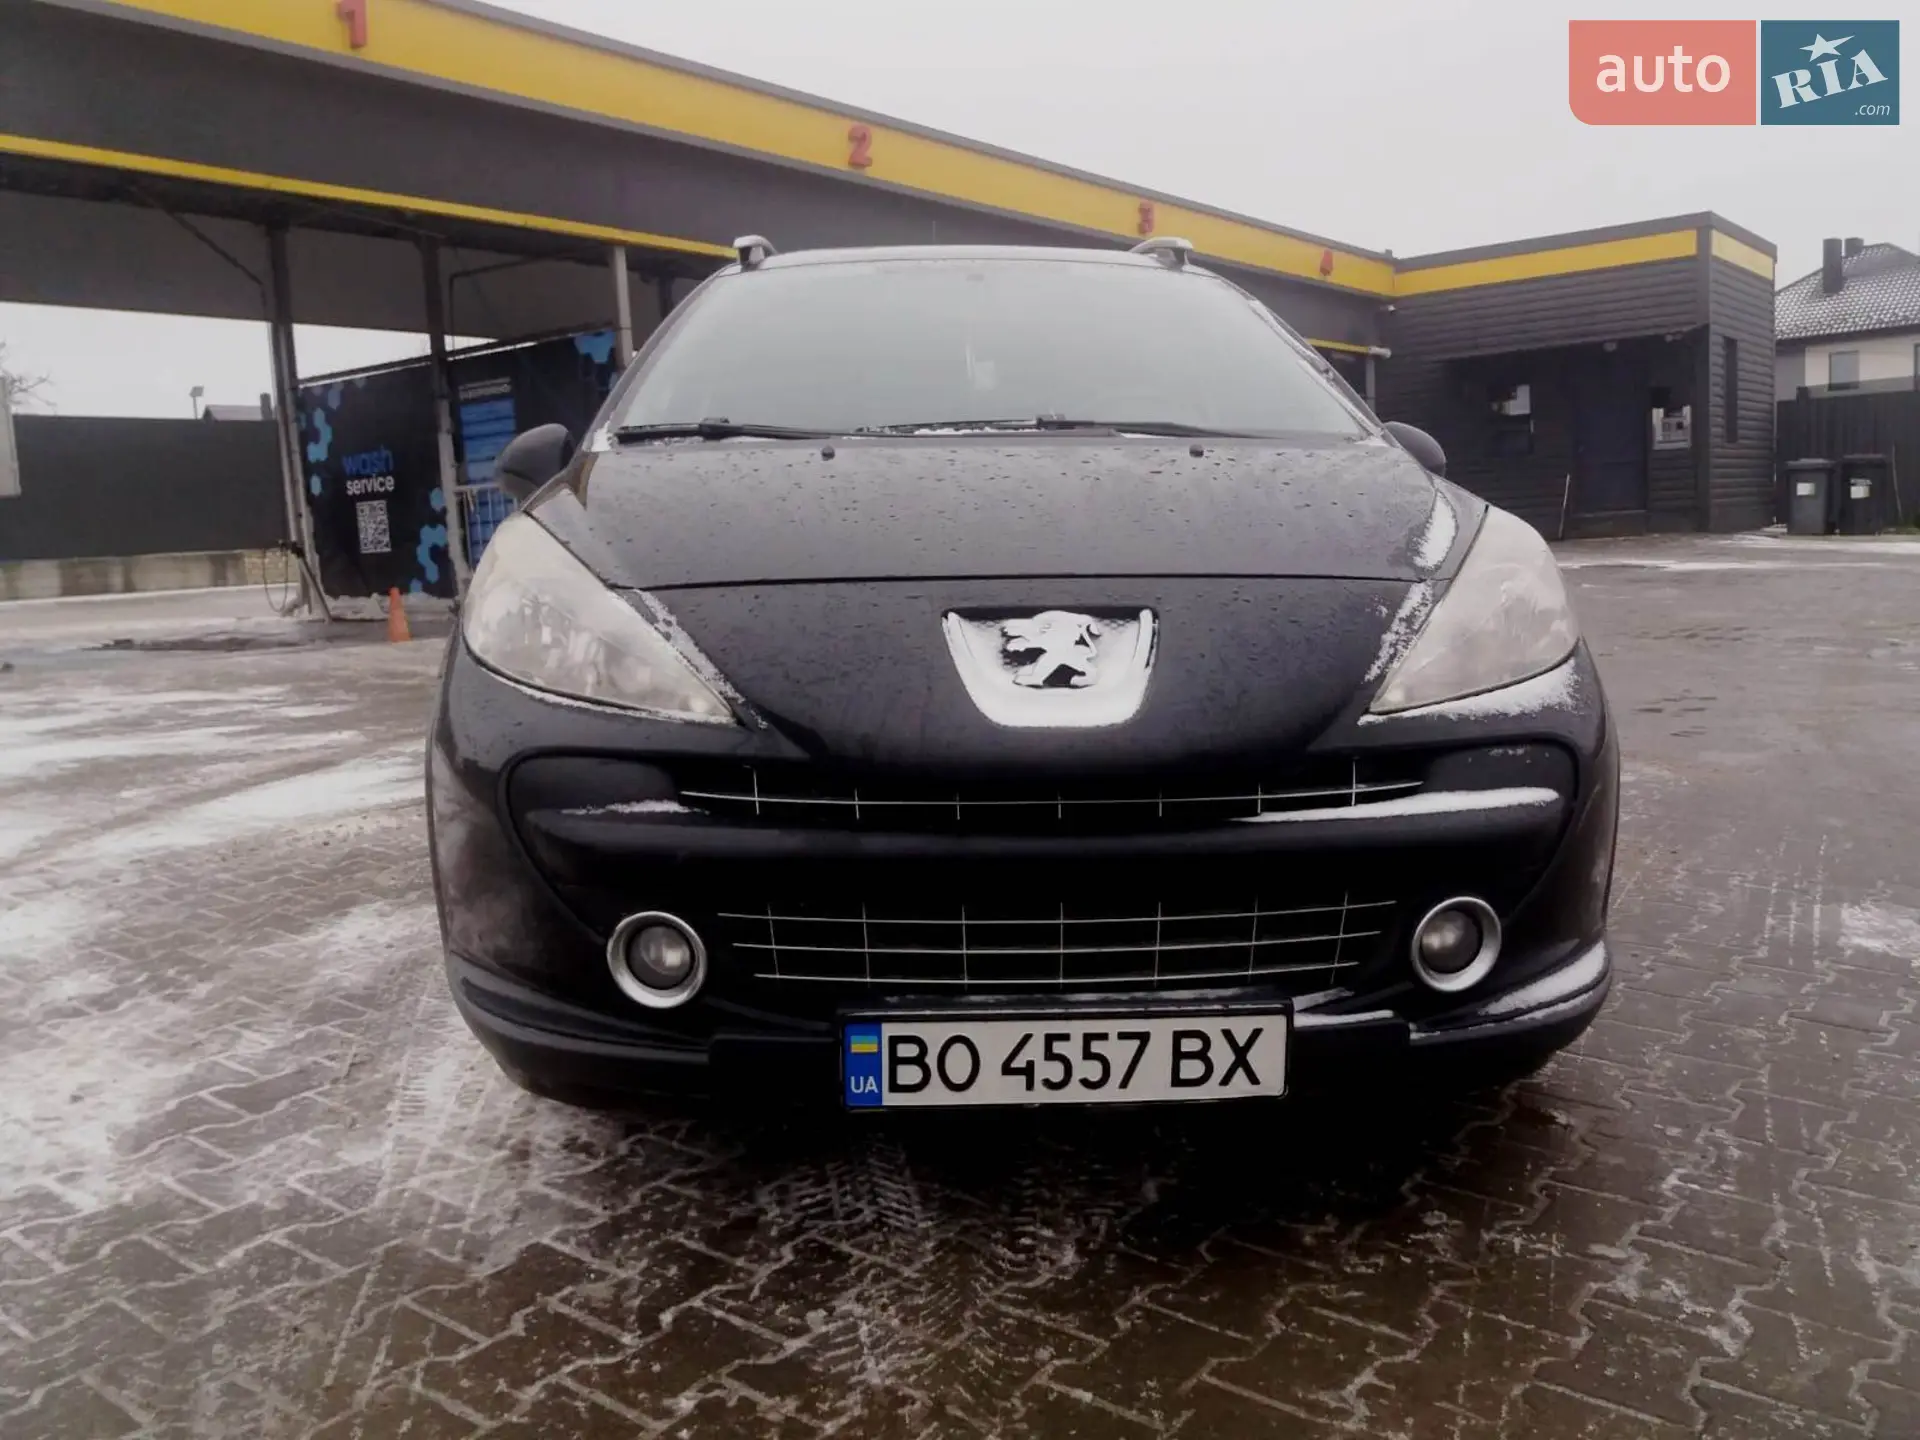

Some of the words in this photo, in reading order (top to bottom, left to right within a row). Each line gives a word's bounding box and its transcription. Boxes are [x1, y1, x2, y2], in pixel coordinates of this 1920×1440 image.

[337, 0, 367, 48] 1
[848, 123, 873, 168] 2
[342, 446, 393, 477] wash
[345, 475, 395, 496] service
[887, 1034, 981, 1094] BO
[1000, 1030, 1151, 1092] 4557
[1170, 1027, 1264, 1089] BX
[850, 1075, 879, 1094] UA
